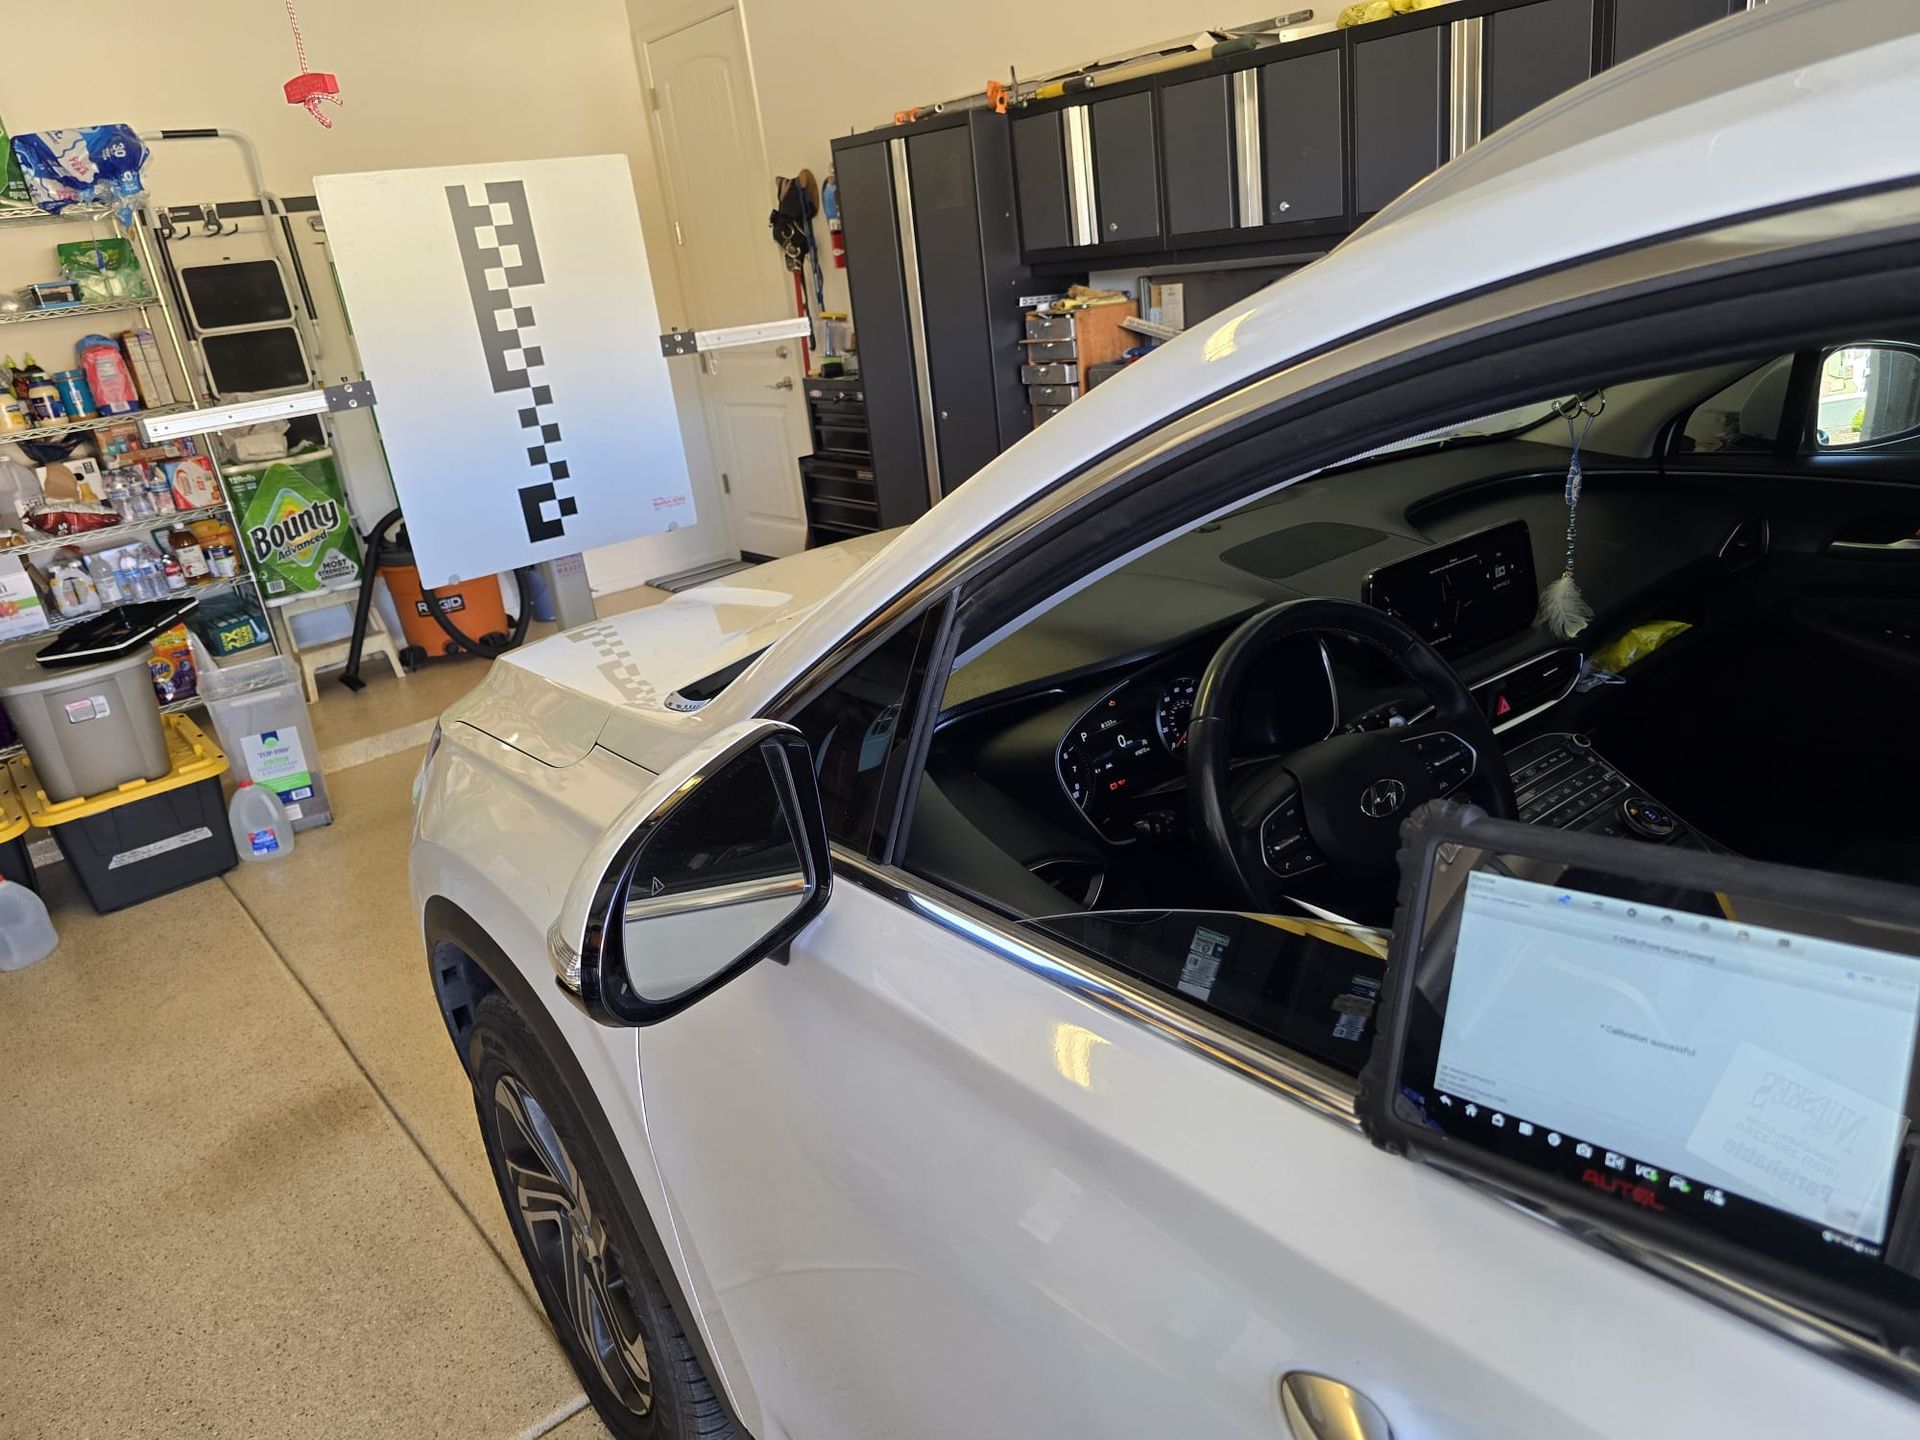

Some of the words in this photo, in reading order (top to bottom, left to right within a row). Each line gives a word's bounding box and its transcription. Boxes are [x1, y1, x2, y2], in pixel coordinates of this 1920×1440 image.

[112, 142, 126, 158] 30
[248, 500, 340, 562] Bounty
[278, 530, 327, 560] Advanced
[323, 559, 347, 570] MOST
[417, 596, 462, 612] RGID
[1081, 732, 1088, 742] P
[1117, 734, 1127, 748] 0
[1582, 1168, 1665, 1211] AUTEL
